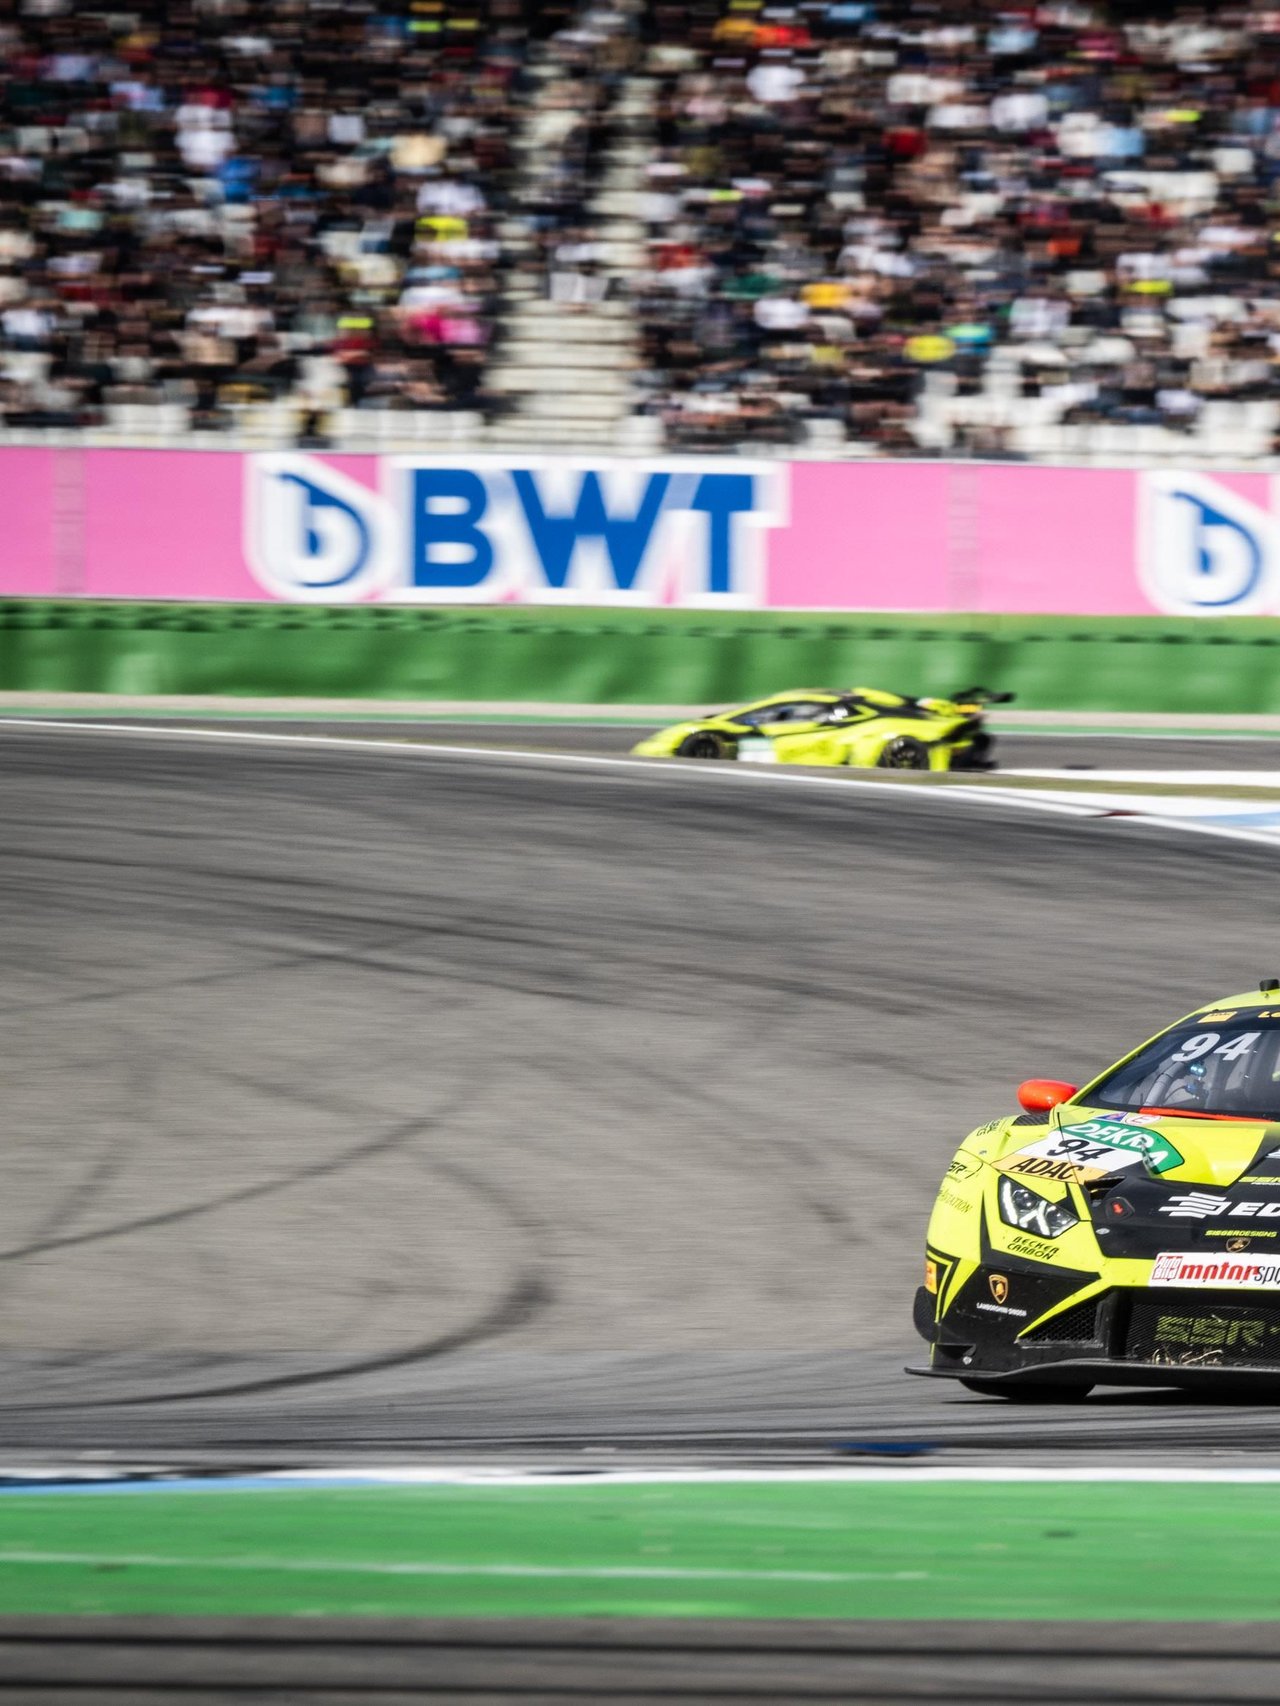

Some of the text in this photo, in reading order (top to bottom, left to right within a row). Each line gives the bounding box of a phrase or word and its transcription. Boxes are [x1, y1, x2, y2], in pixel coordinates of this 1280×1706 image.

[411, 468, 756, 592] BWT
[1172, 1033, 1261, 1061] 94
[1047, 1139, 1116, 1162] 94
[1008, 1157, 1085, 1180] ADAC
[1007, 1242, 1055, 1261] CARBON
[1012, 1236, 1060, 1254] BECKER
[1178, 1261, 1262, 1281] motor
[1153, 1315, 1266, 1346] SSR
